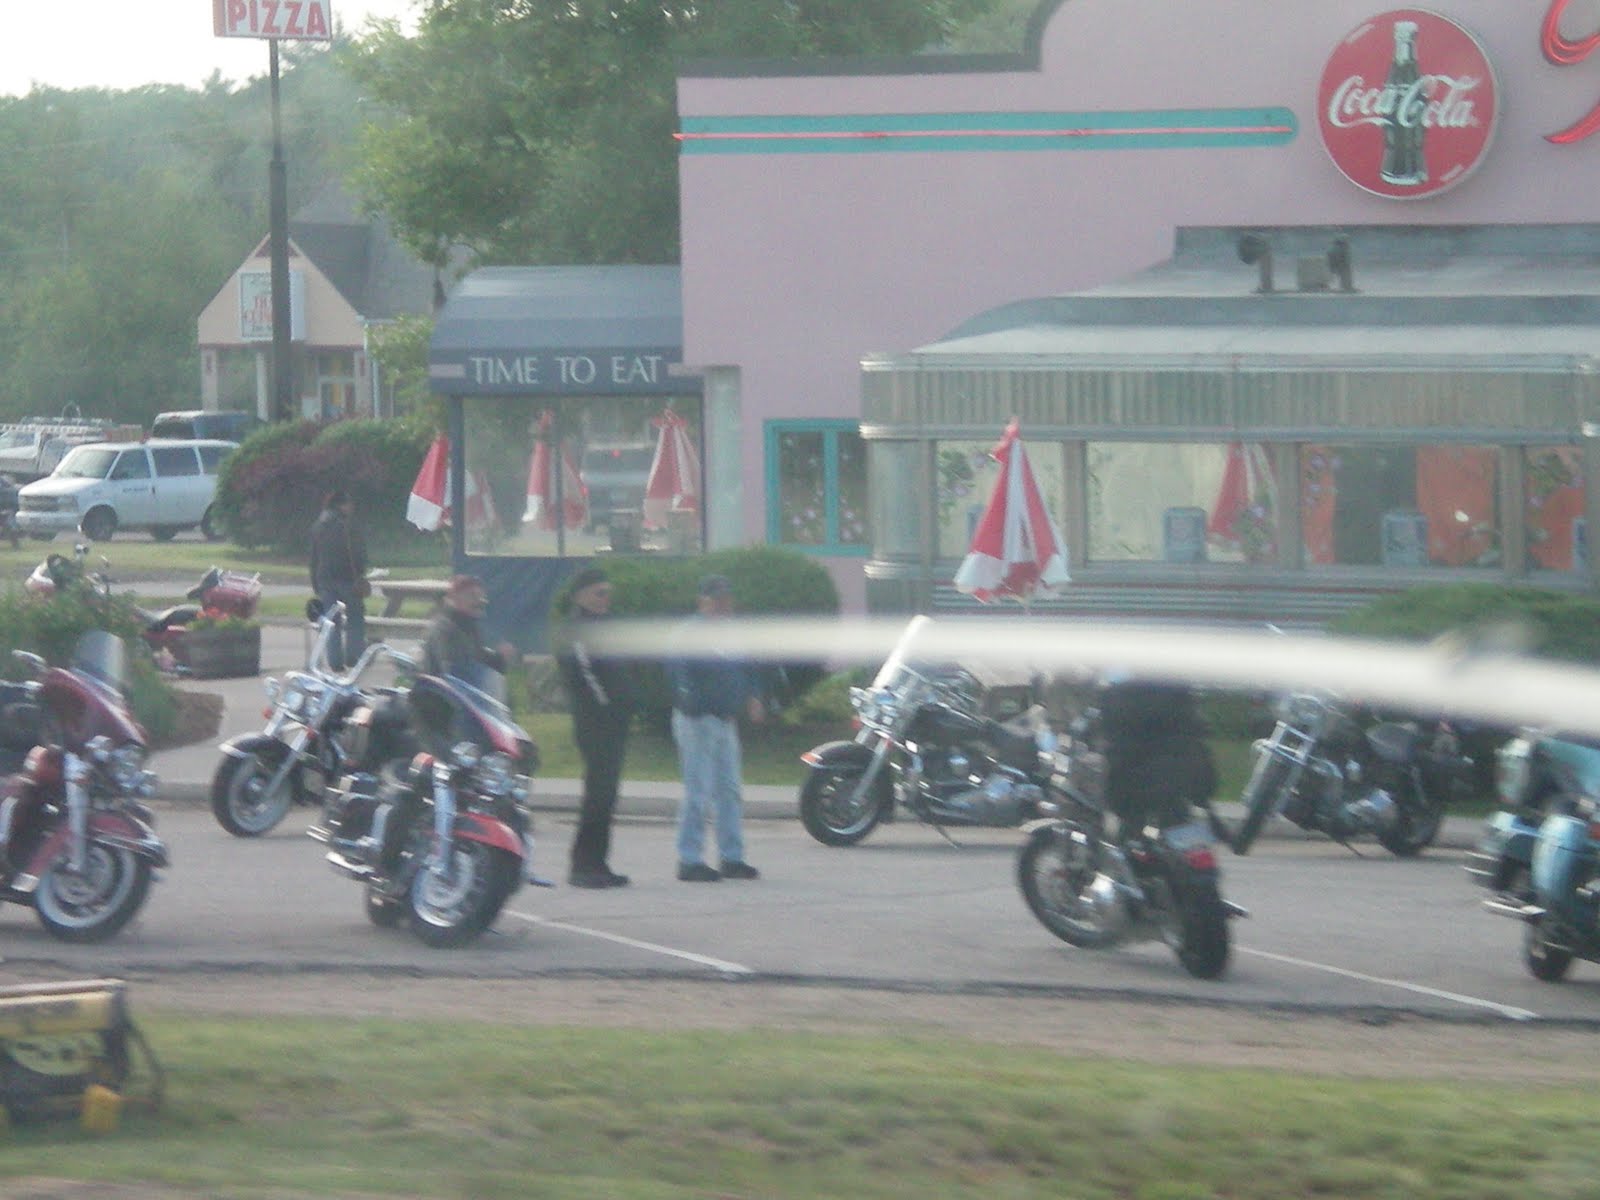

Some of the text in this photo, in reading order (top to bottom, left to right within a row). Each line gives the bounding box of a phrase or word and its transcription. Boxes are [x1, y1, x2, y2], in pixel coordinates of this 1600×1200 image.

[227, 0, 327, 34] PIZZA
[469, 356, 662, 385] TIME TO EAT
